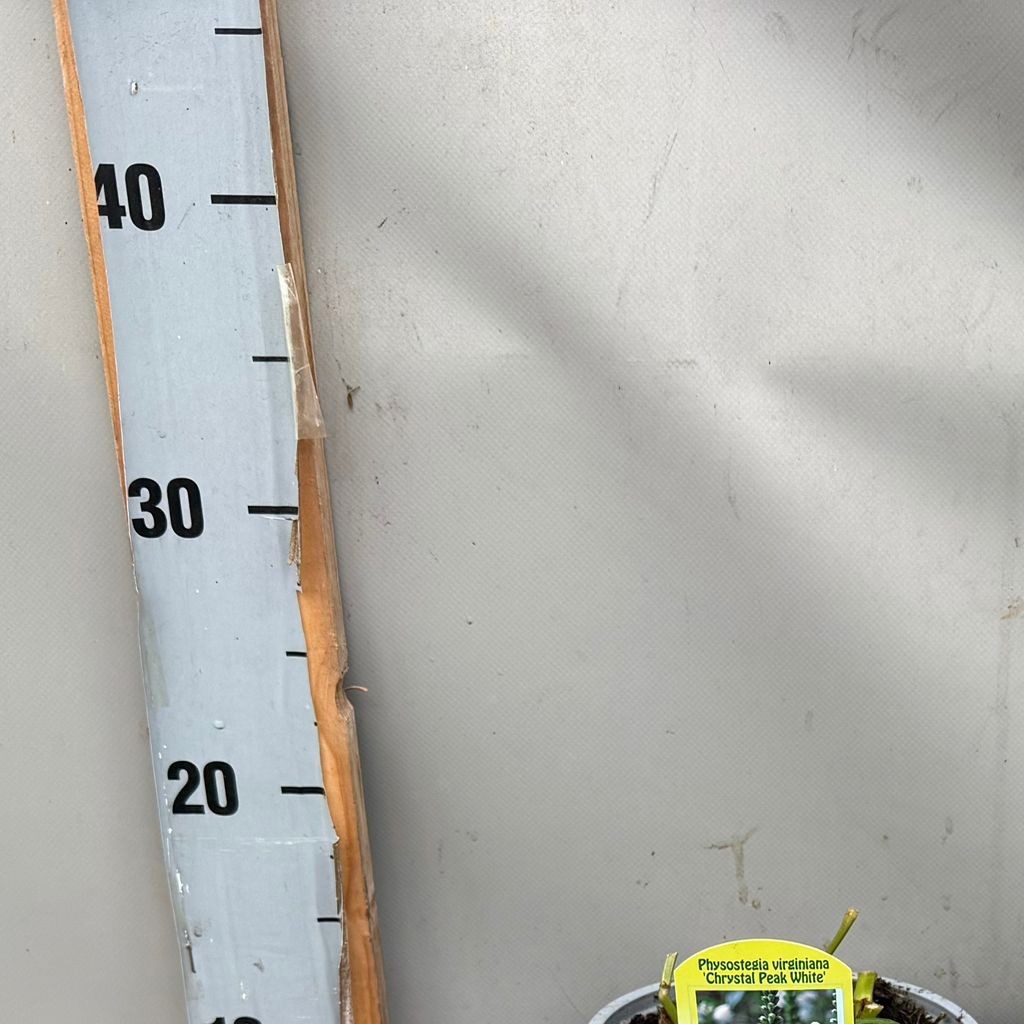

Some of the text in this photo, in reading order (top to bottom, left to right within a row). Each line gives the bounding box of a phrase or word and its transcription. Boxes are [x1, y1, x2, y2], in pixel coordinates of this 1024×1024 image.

[94, 163, 166, 231] 40
[127, 477, 204, 538] 30
[167, 760, 239, 816] 20
[698, 957, 829, 971] Physostegia virginiana
[703, 971, 826, 985] 'Chrystal Peak White'
